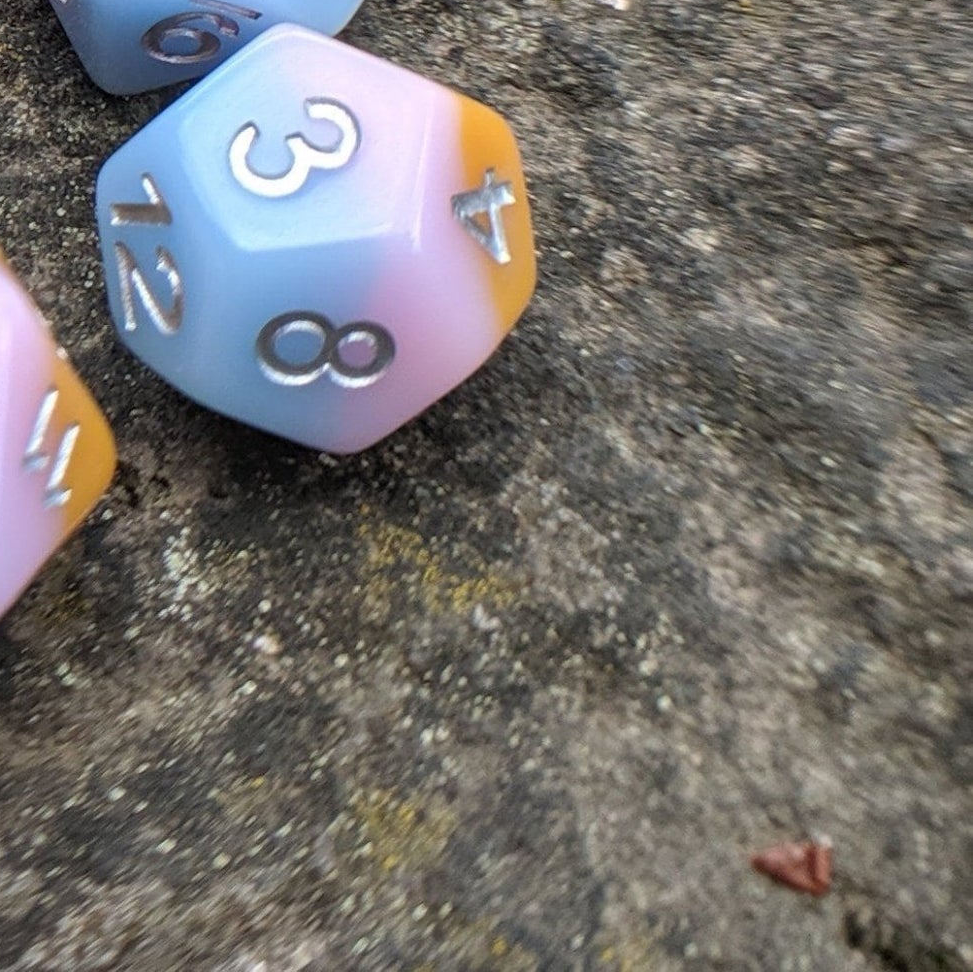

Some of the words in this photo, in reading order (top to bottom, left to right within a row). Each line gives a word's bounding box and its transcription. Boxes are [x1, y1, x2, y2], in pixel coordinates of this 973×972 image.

[229, 96, 362, 198] 3
[110, 171, 185, 336] 12
[451, 167, 516, 265] 4
[254, 309, 397, 389] 8
